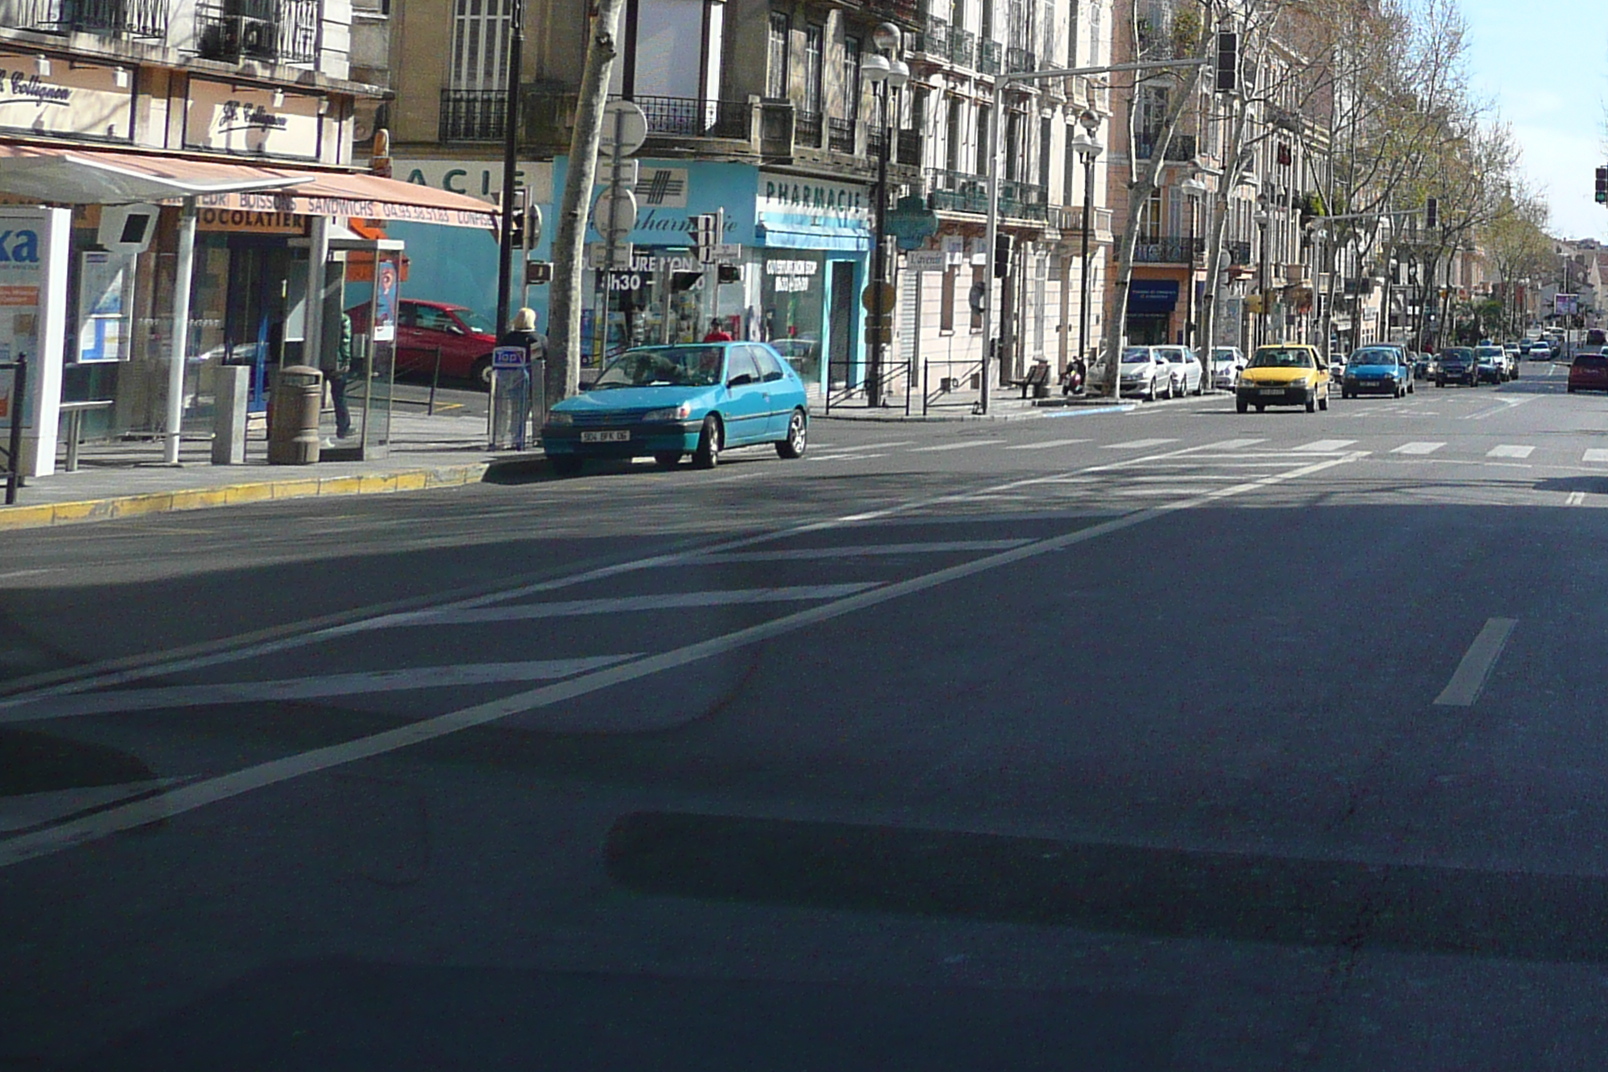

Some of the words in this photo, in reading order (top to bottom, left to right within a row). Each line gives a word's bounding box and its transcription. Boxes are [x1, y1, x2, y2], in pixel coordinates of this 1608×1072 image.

[240, 193, 297, 212] BOISSONS
[308, 197, 374, 217] SANDWICHS
[766, 181, 861, 214] PHARMACIE
